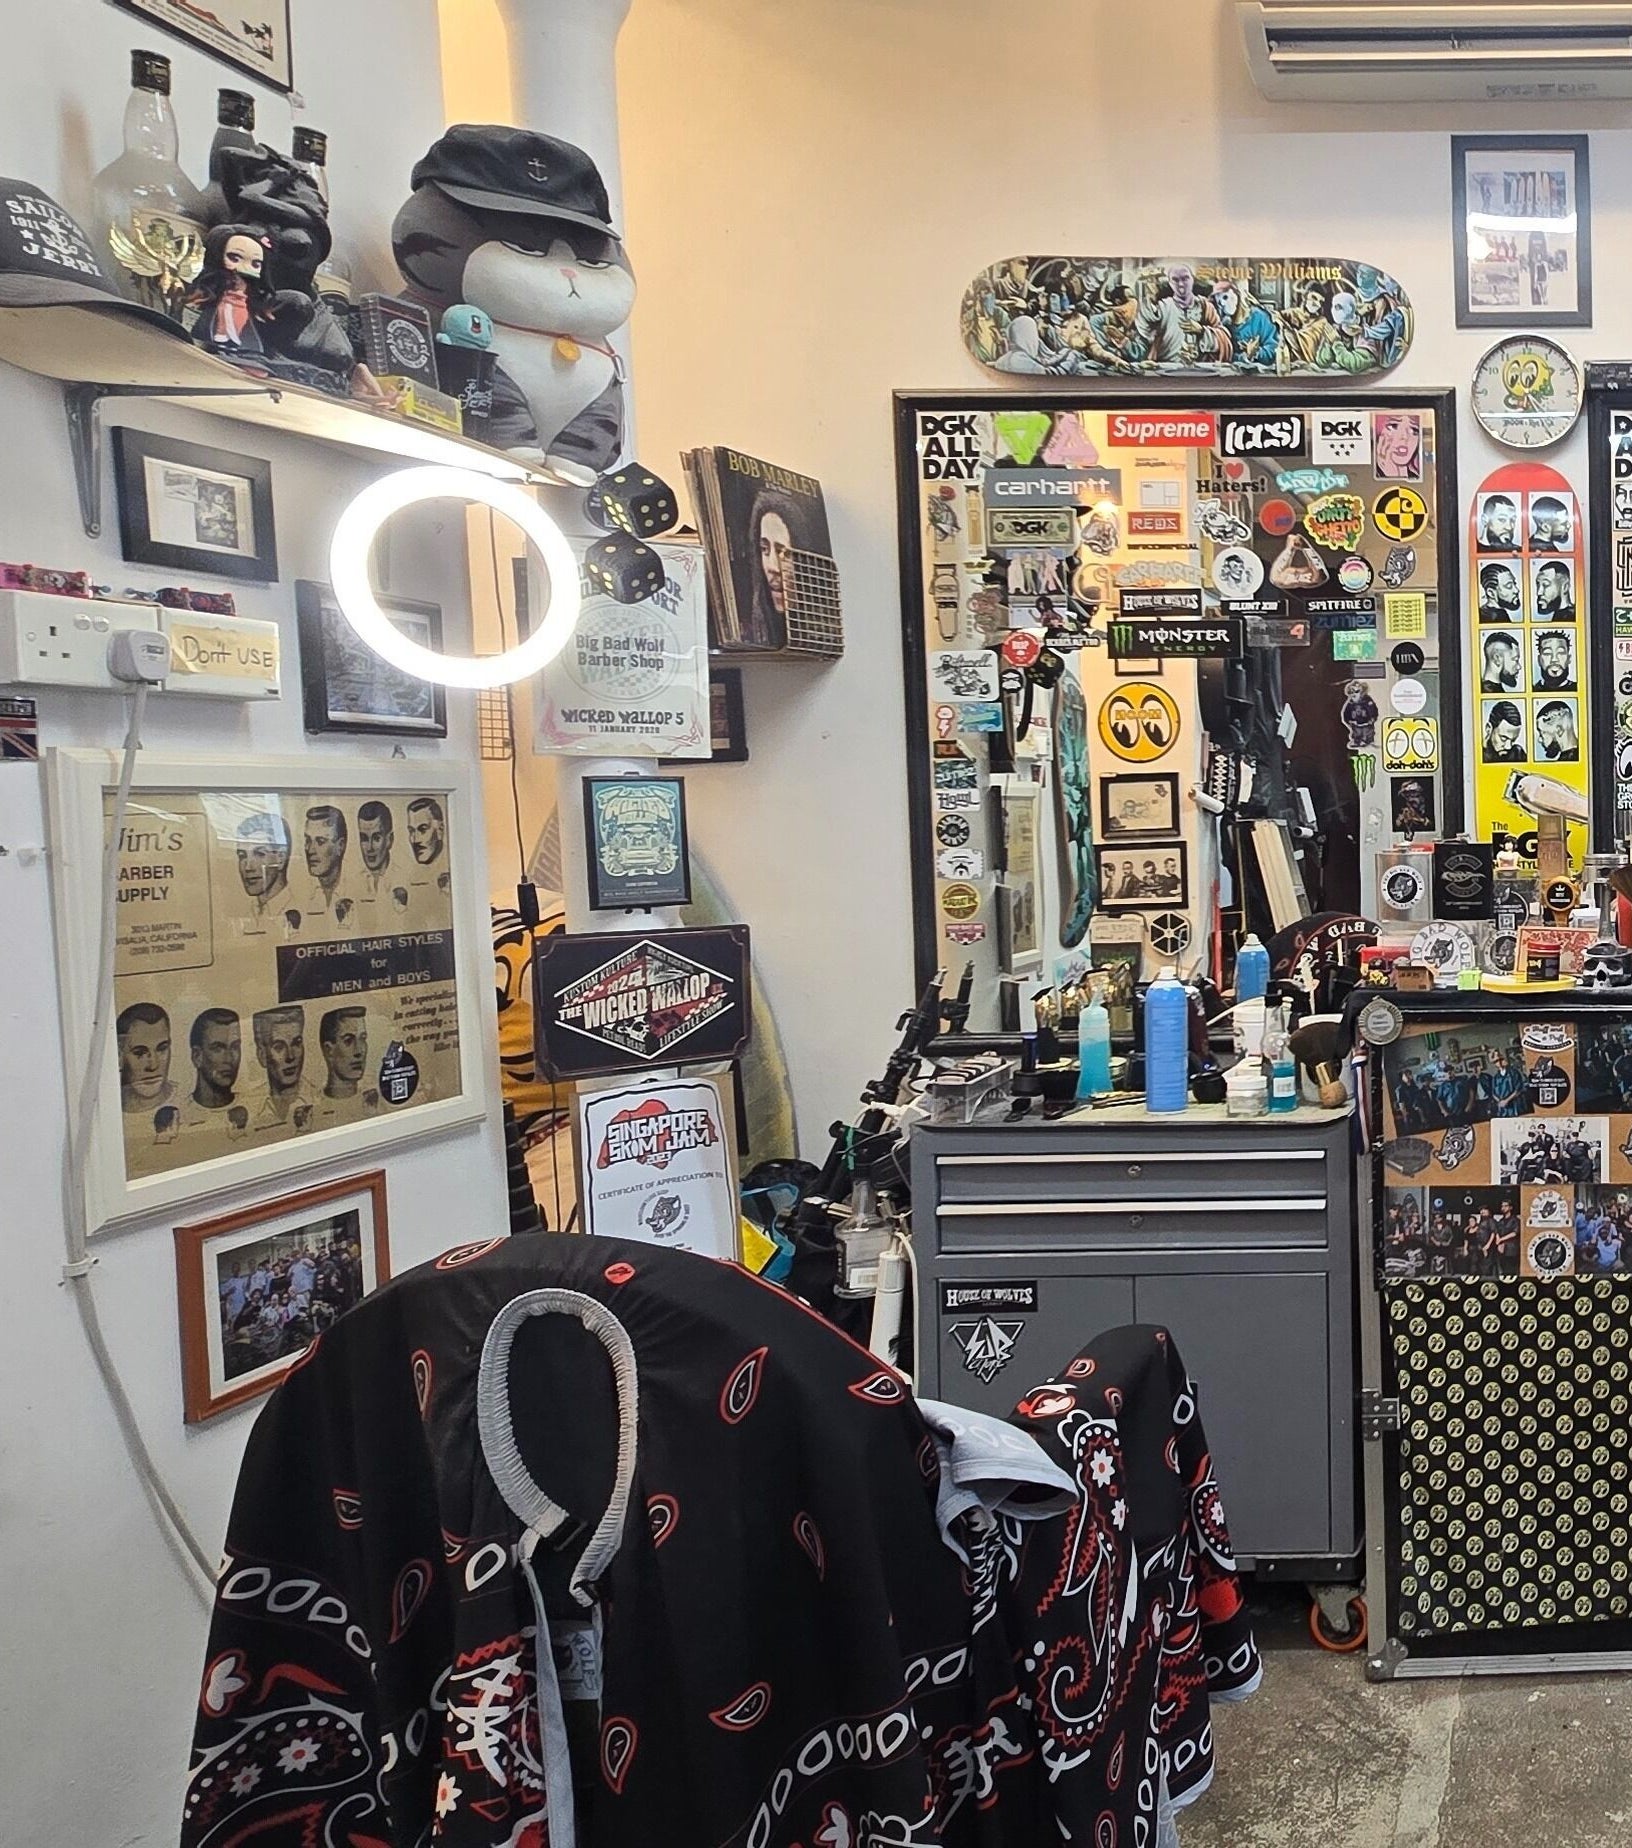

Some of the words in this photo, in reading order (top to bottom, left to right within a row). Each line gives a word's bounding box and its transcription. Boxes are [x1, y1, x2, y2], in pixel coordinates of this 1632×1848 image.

[22, 242, 103, 277] JERRY
[921, 415, 979, 436] DGK
[1113, 416, 1210, 444] Supreme
[1321, 421, 1363, 437] DGK
[923, 437, 980, 458] ALL
[728, 450, 761, 479] BOB
[765, 464, 820, 498] MARLEY
[994, 478, 1111, 495] carhartt
[1195, 478, 1267, 493] Haters!
[1011, 520, 1049, 534] DGK
[1308, 600, 1362, 611] SPITFIRE
[1316, 614, 1376, 629] zumiez
[1138, 627, 1230, 644] MONSTER
[1291, 624, 1305, 639] 4
[576, 634, 599, 649] Big
[603, 636, 630, 650] Bad
[634, 637, 665, 652] Wolf
[237, 648, 273, 667] USE
[577, 652, 627, 667] Barber
[630, 654, 665, 671] Shop
[675, 711, 685, 725] 5
[599, 725, 636, 734] JANUARY
[1491, 821, 1509, 831] The
[118, 865, 174, 881] ARBER
[116, 886, 169, 903] UPPLY
[1422, 922, 1445, 938] BAD
[295, 943, 356, 959] OFFICIAL
[362, 938, 393, 952] HAIR
[398, 933, 444, 948] STYLES
[370, 957, 388, 969] for
[331, 979, 363, 993] MEN
[368, 975, 392, 987] and
[397, 970, 432, 984] BOYS
[563, 972, 600, 1003] KUSTOM
[599, 950, 639, 982] KULTURE
[607, 966, 646, 995] 2024
[558, 1005, 583, 1021] THE
[583, 988, 649, 1030] WICKED
[651, 972, 711, 1012] WALLOP
[659, 1012, 701, 1048] LIFESTYLE
[701, 1001, 723, 1022] SHOW
[607, 1111, 709, 1144] SINGAPORE
[609, 1136, 657, 1162] SKIM
[665, 1129, 711, 1151] JAM
[597, 1183, 644, 1200] CERTIFICATE
[645, 1181, 656, 1190] OF
[656, 1172, 715, 1187] APPRECIATION
